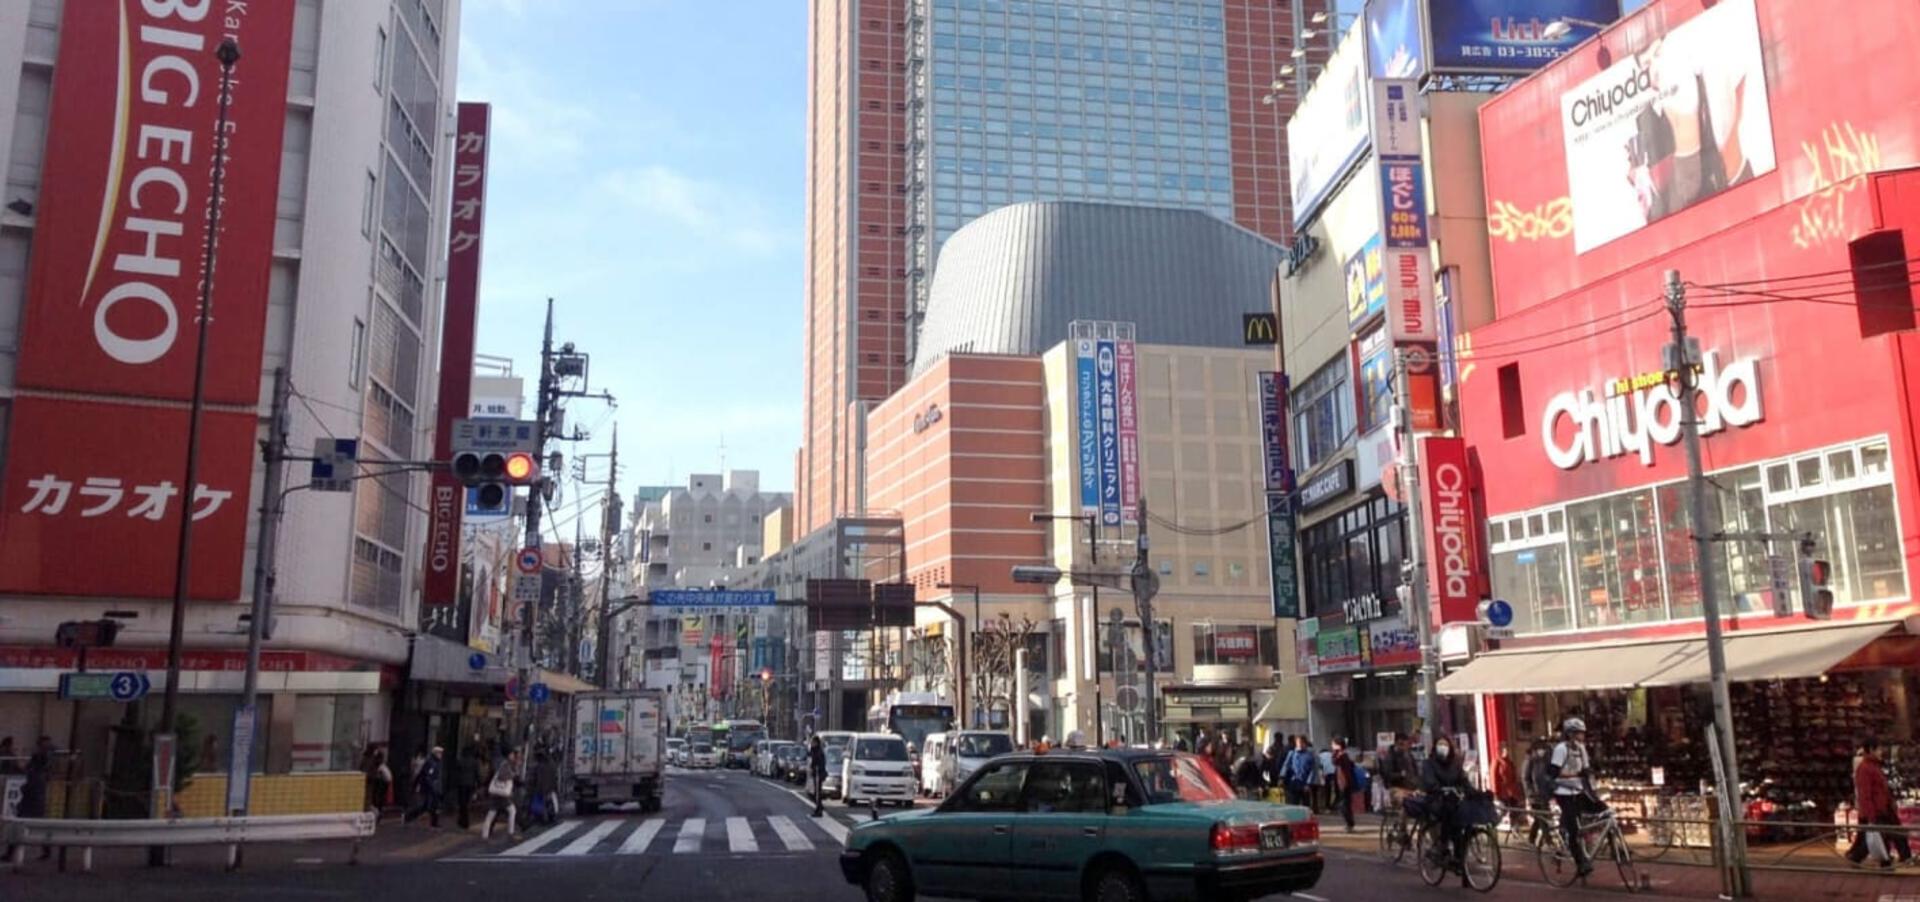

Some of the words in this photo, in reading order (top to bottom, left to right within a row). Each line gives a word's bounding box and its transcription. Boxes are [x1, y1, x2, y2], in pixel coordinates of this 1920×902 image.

[1571, 66, 1651, 127] Chiyoda
[452, 131, 485, 253] カラオケ
[1389, 166, 1414, 209] ほぐし
[94, 124, 193, 364] ECHO
[1400, 254, 1419, 288] mini
[1403, 299, 1423, 334] mini
[1542, 351, 1765, 469] Chiyoda
[21, 474, 232, 522] カラオケ
[436, 485, 453, 520] BIG
[431, 521, 450, 573] ECHO
[1436, 463, 1472, 598] Chiyoda
[117, 676, 131, 695] 3
